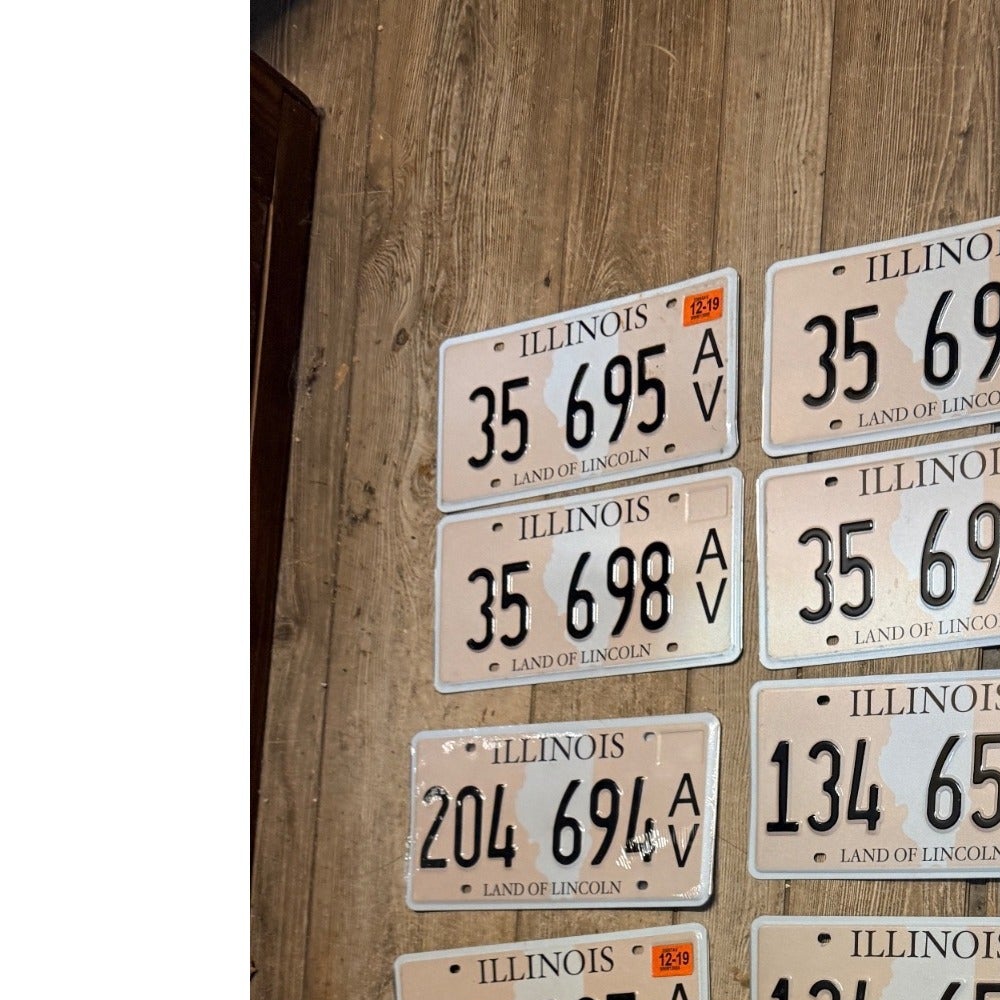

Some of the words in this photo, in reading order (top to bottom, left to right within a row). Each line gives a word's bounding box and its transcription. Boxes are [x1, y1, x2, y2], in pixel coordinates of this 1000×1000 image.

[690, 297, 719, 315] 12-19
[520, 303, 648, 357] ILLINOIS
[802, 304, 879, 407] 35
[468, 376, 529, 468] 35
[566, 343, 666, 448] 695
[858, 408, 908, 428] LAND
[913, 402, 938, 418] OF
[513, 465, 554, 486] LAND
[557, 461, 578, 476] OF
[581, 447, 649, 473] LINCOLN
[518, 495, 650, 541] ILLINOIS
[799, 519, 874, 622] 35
[467, 560, 530, 651] 35
[566, 541, 671, 640] 698
[854, 625, 905, 646] LAND
[909, 621, 934, 637] OF
[511, 657, 554, 672] LAND
[557, 652, 577, 666] OF
[581, 643, 652, 664] LINCOLN
[491, 732, 625, 765] ILLINOIS
[766, 738, 880, 833] 134
[420, 785, 516, 868] 204
[553, 776, 657, 866] 694
[840, 848, 889, 863] LAND
[893, 847, 918, 862] OF
[483, 883, 525, 897] LAND
[527, 882, 548, 895] OF
[552, 880, 622, 895] LINCOLN
[477, 945, 615, 985] ILLINOIS
[659, 951, 689, 966] 12-19
